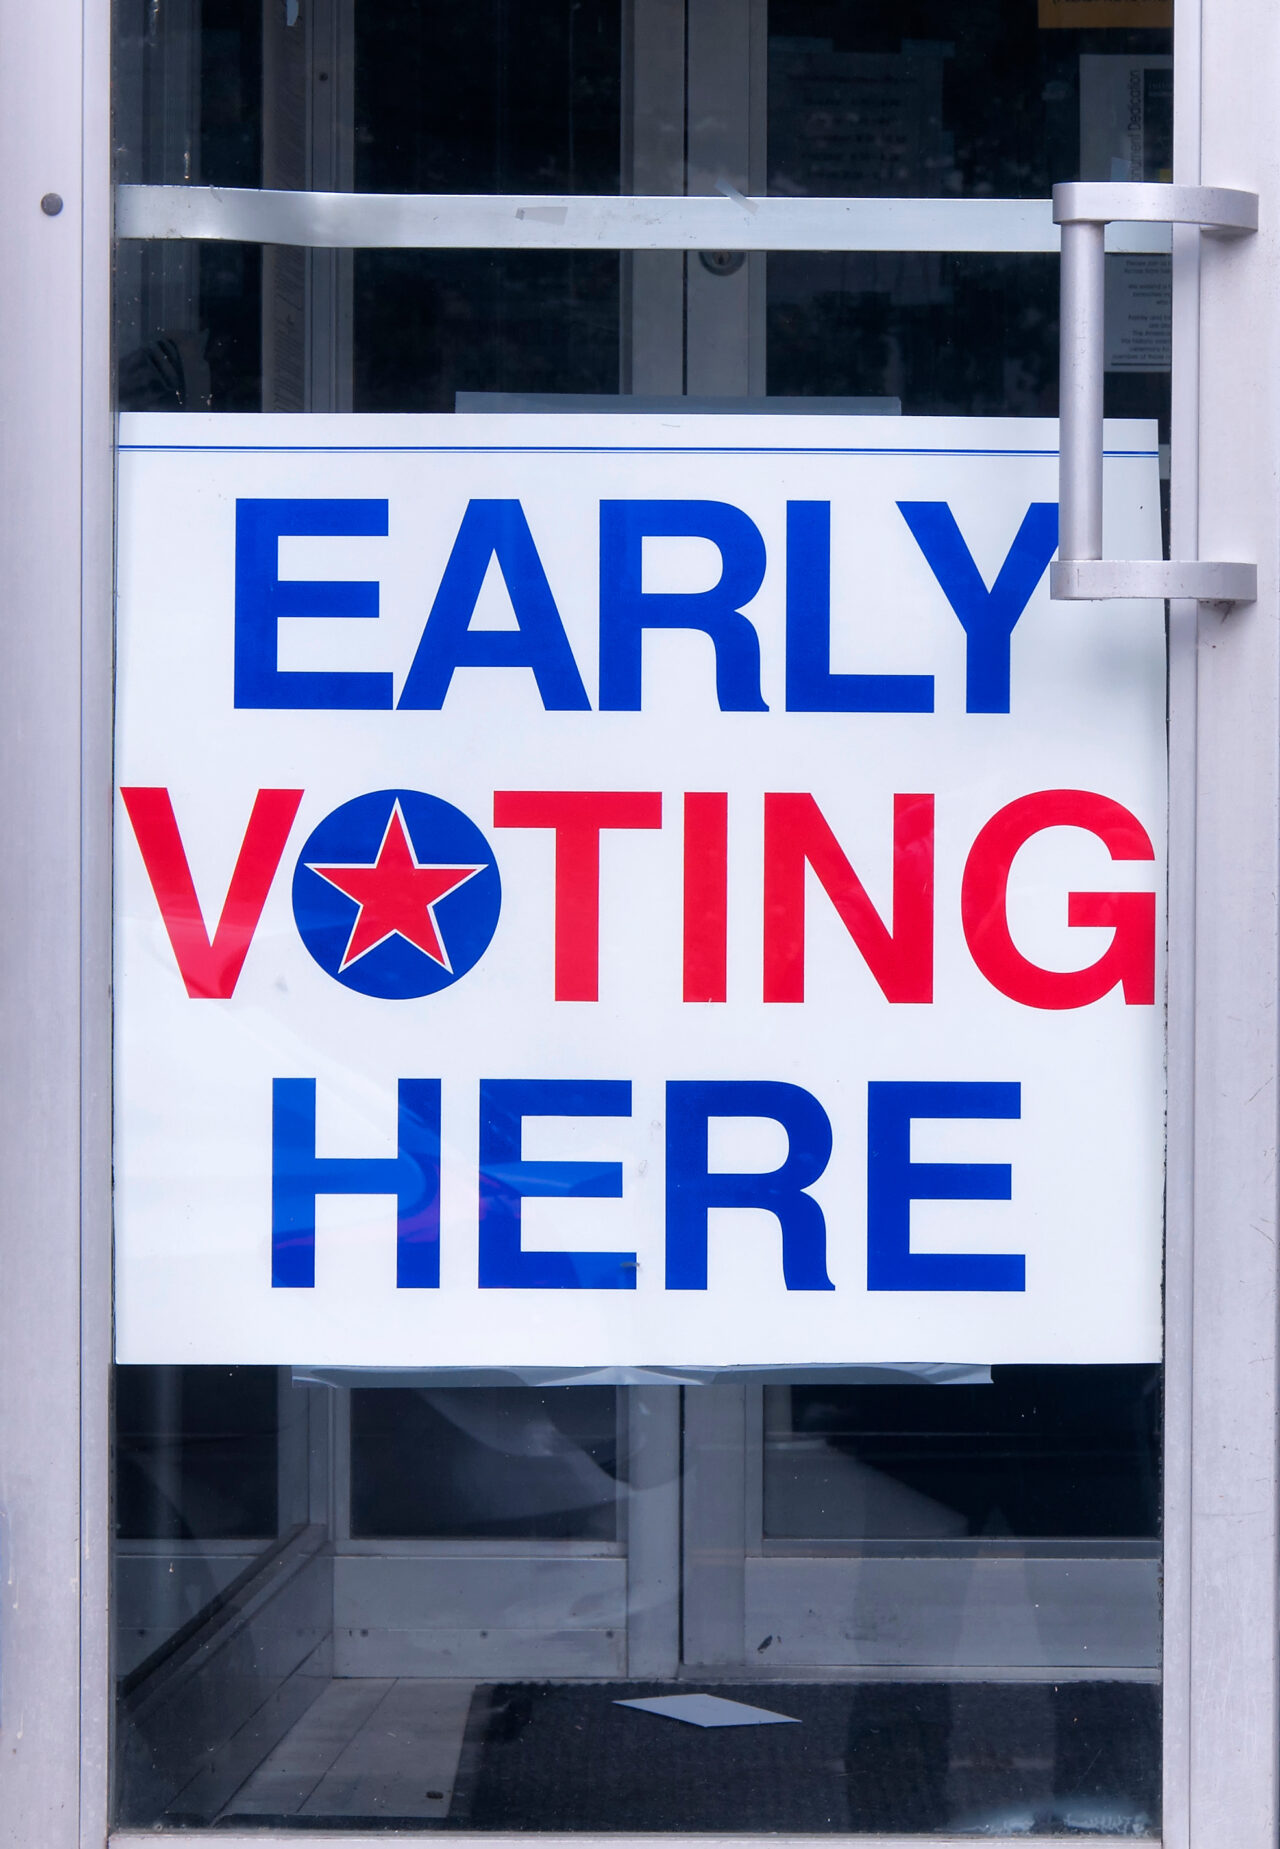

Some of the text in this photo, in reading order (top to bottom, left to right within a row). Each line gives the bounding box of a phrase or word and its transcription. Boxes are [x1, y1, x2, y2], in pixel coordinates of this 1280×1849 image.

[234, 498, 1059, 714] EARLY
[120, 787, 1156, 1010] VOTING
[271, 1078, 1026, 1292] HERE
